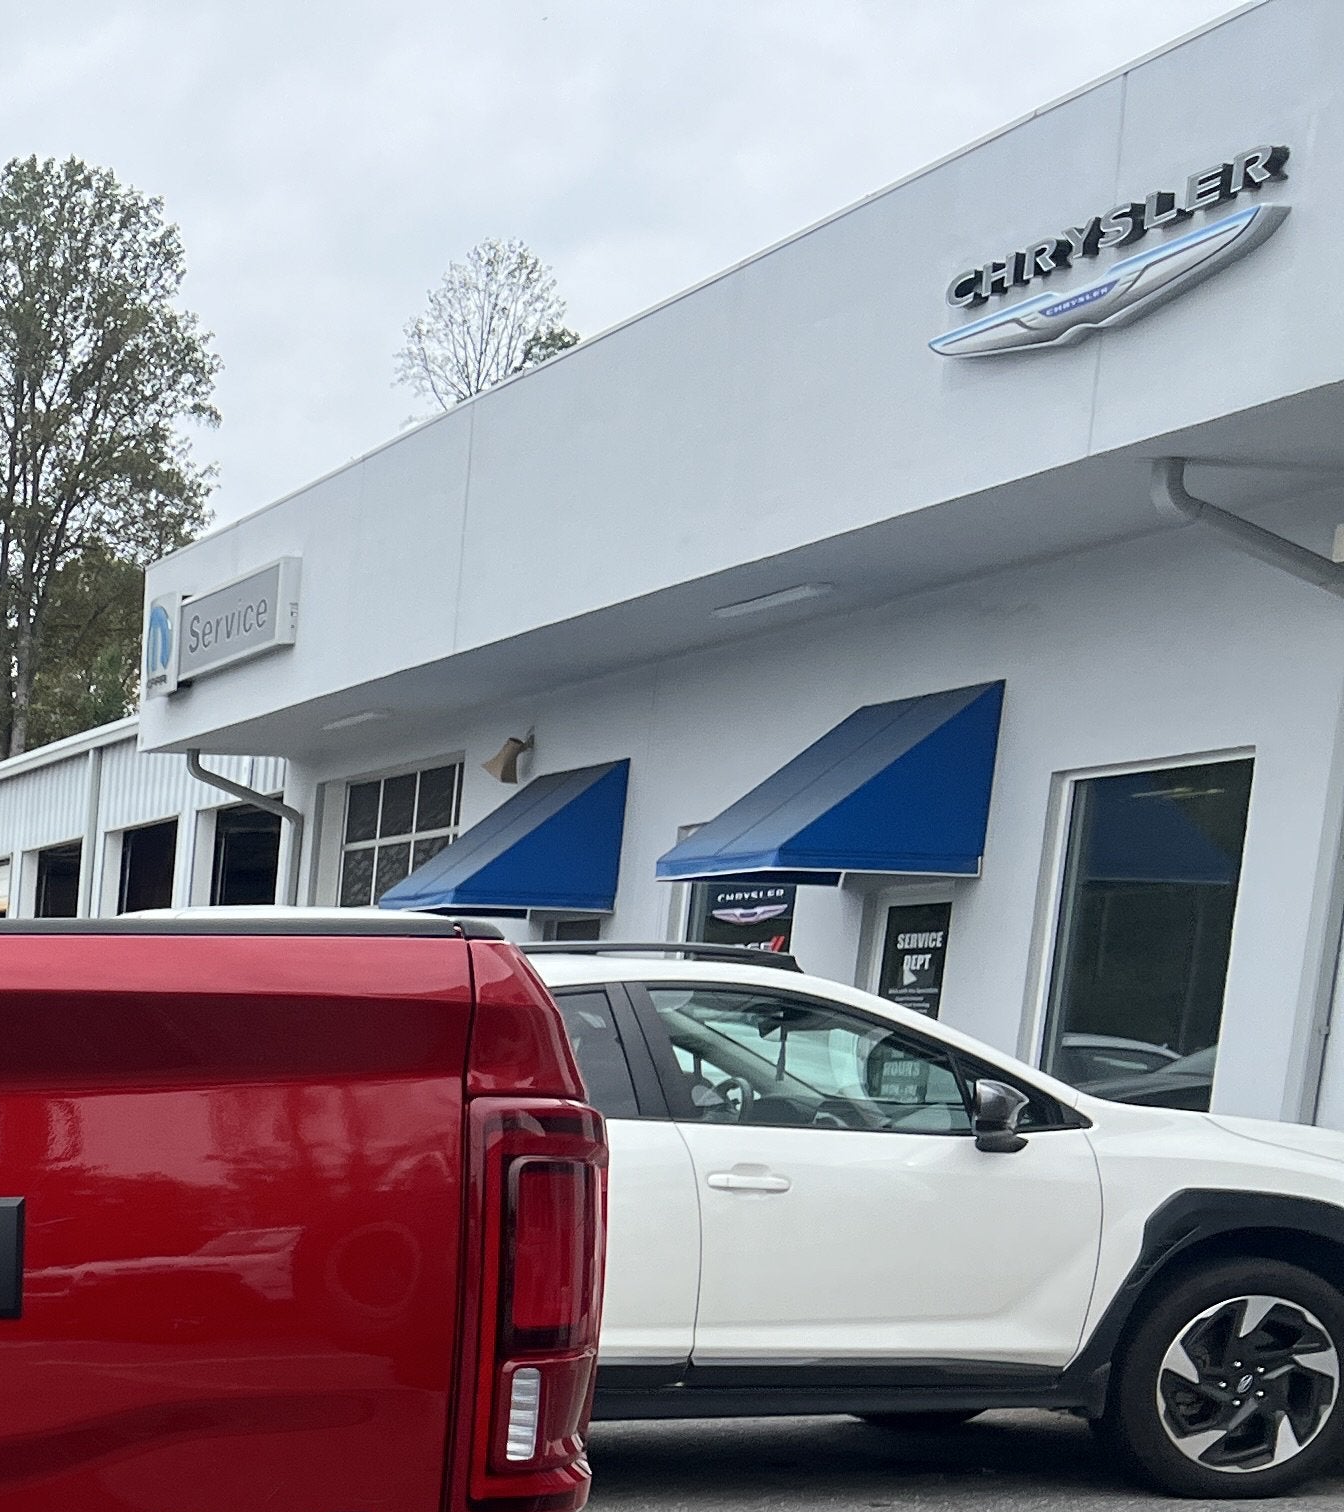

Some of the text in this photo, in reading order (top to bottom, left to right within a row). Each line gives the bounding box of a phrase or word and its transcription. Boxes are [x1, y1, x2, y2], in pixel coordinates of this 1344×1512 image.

[945, 144, 1280, 308] CHRYSLER
[188, 597, 268, 654] Service
[717, 888, 784, 902] CHRYSLER
[896, 931, 943, 950] SERVICE
[903, 953, 932, 971] DEPT
